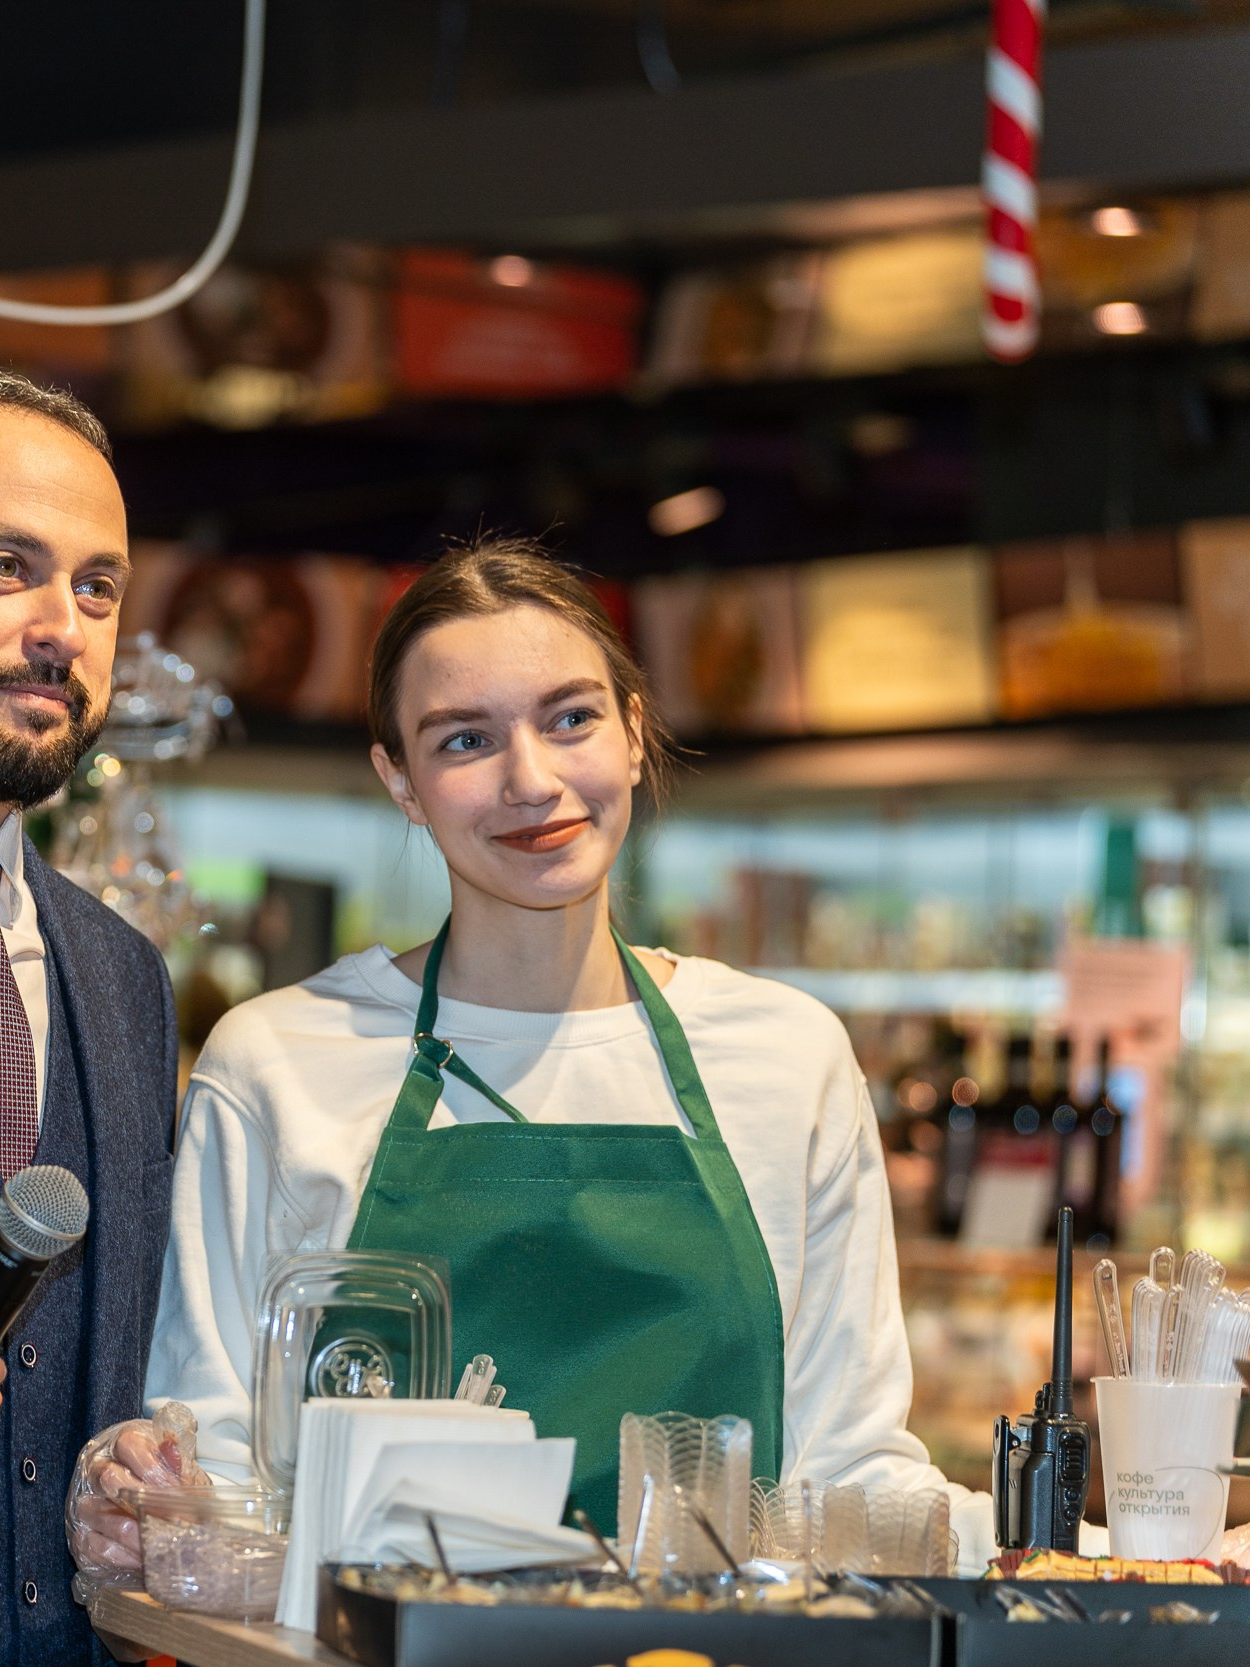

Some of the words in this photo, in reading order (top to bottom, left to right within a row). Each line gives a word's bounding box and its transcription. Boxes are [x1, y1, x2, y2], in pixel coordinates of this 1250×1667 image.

[1116, 1471, 1154, 1487] кофе
[1118, 1487, 1185, 1503] культура
[1119, 1502, 1190, 1517] открытия
